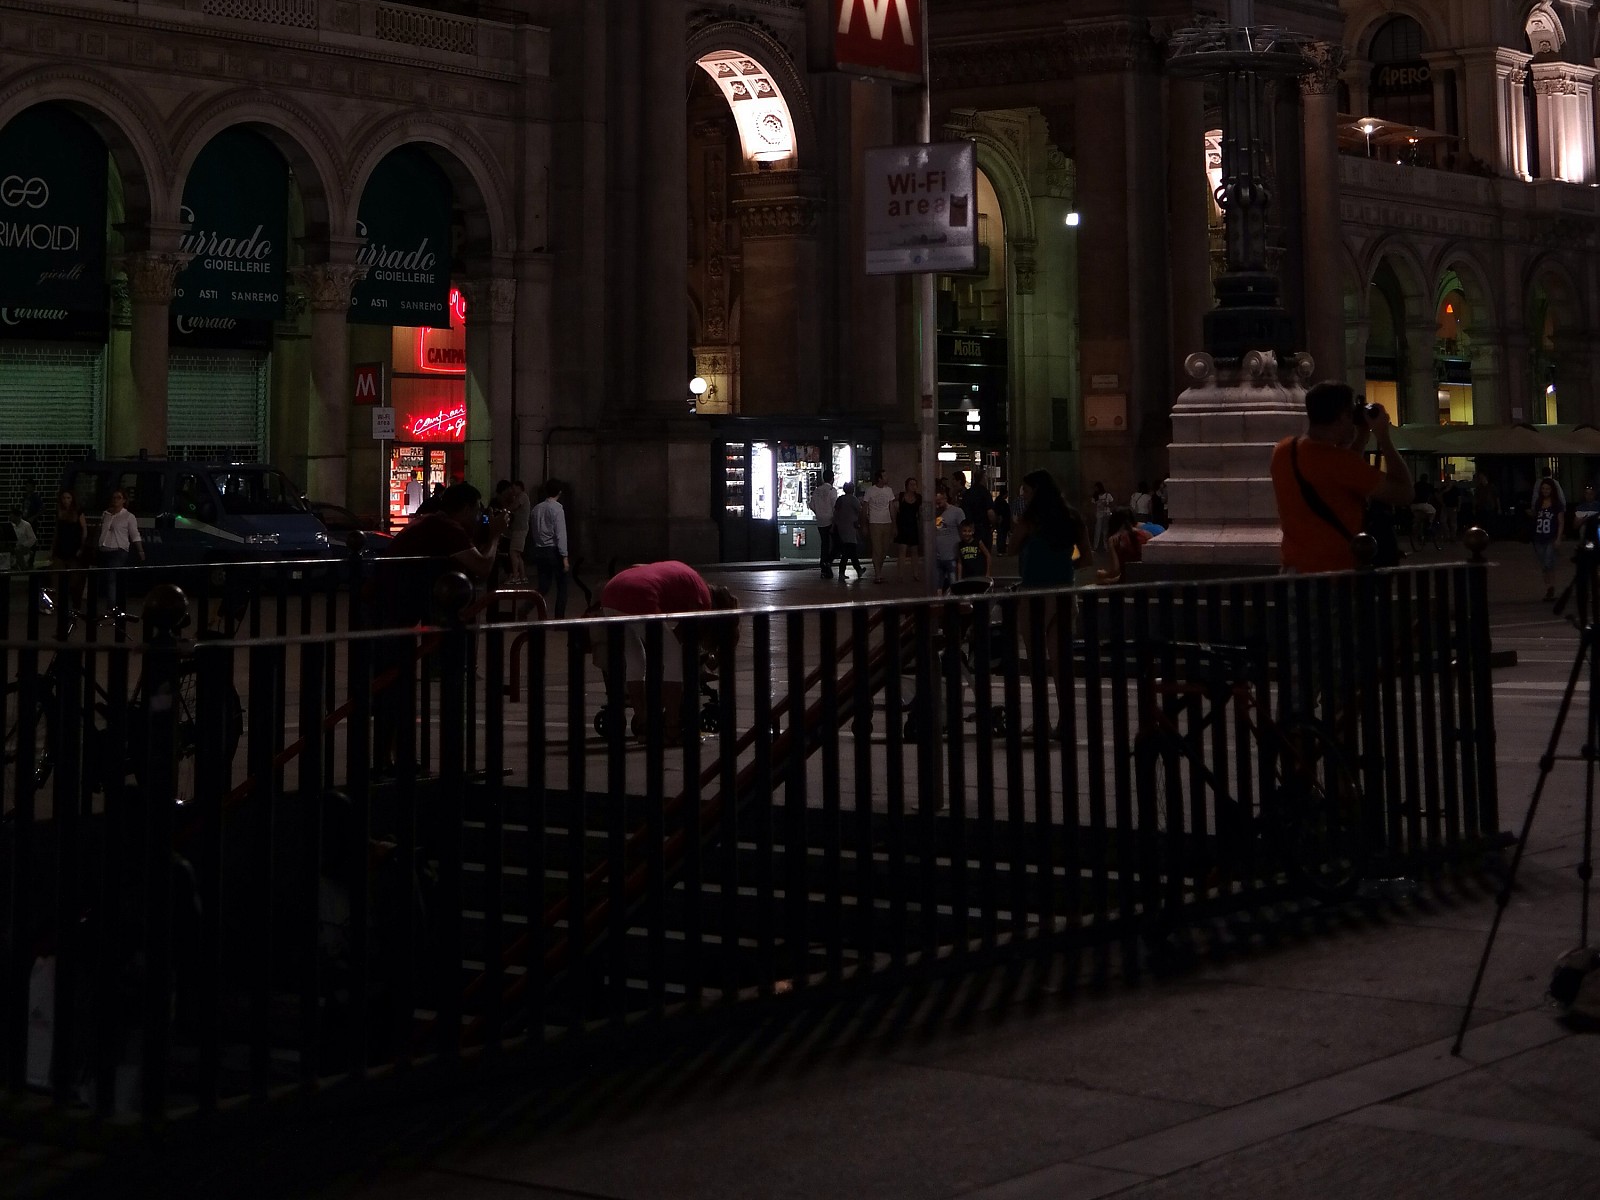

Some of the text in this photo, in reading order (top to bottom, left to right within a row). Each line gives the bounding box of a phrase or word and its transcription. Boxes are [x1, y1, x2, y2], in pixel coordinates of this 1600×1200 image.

[887, 171, 946, 195] Wi-Fi
[887, 198, 946, 217] area
[179, 205, 272, 260] urrado
[203, 258, 271, 273] GIOIELLERIE
[374, 270, 436, 284] GIOIELLERIE
[198, 289, 219, 300] ASTI
[231, 291, 280, 303] SANREMO
[370, 298, 389, 308] ASTI
[400, 300, 444, 312] SANREMO
[953, 339, 982, 357] Motta
[355, 373, 377, 397] M
[1535, 518, 1551, 534] 28
